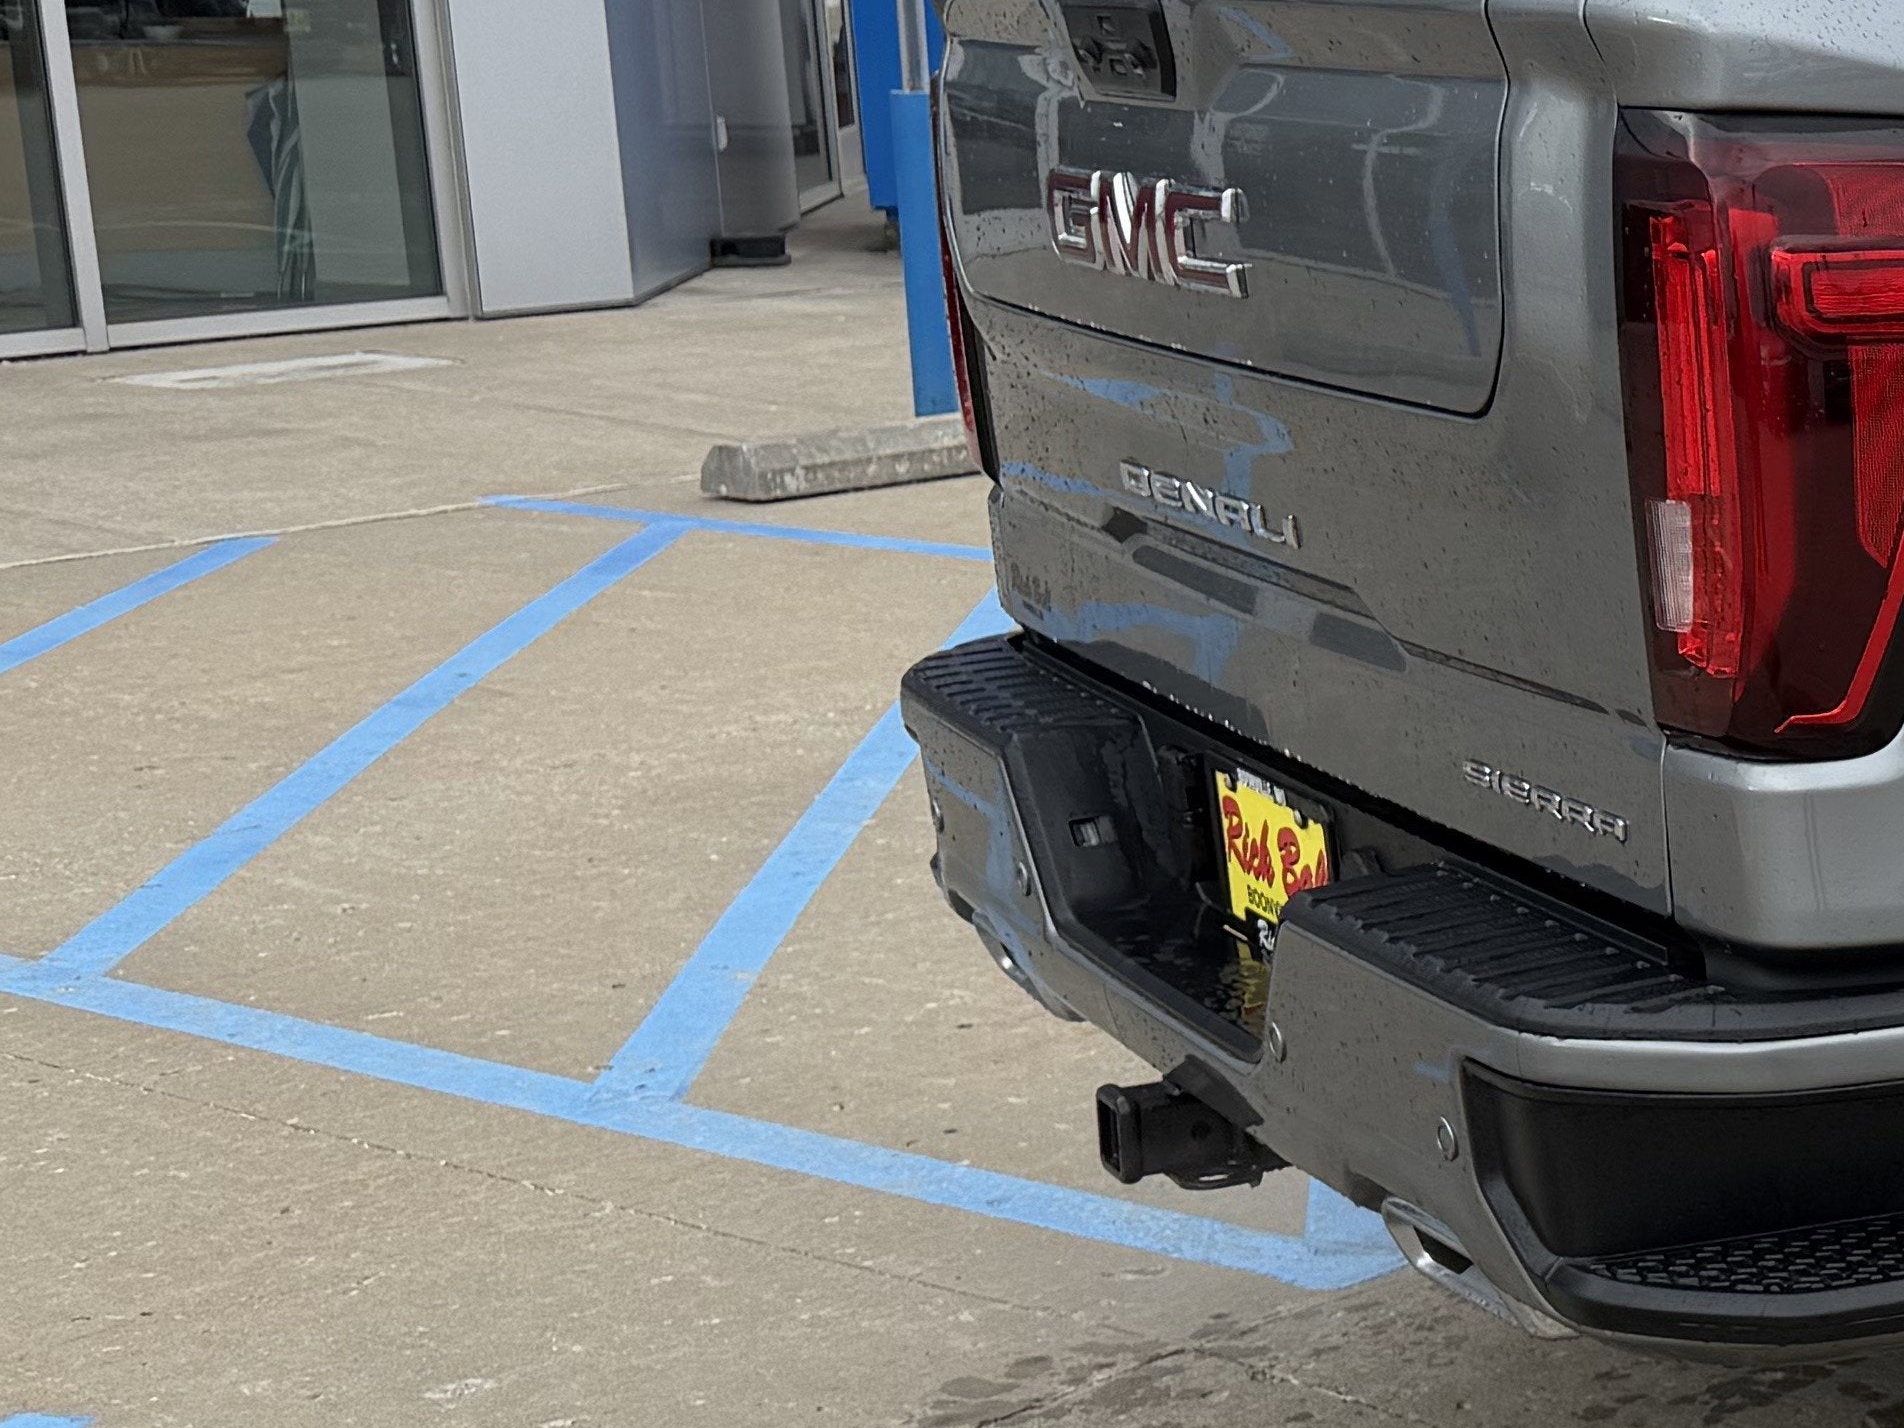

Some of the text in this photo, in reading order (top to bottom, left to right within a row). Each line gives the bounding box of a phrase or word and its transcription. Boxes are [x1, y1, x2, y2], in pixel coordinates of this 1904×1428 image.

[1047, 170, 1250, 300] GMC
[1119, 460, 1300, 551] DENALI
[1222, 795, 1275, 888] Rick
[1462, 759, 1629, 846] SIERRA
